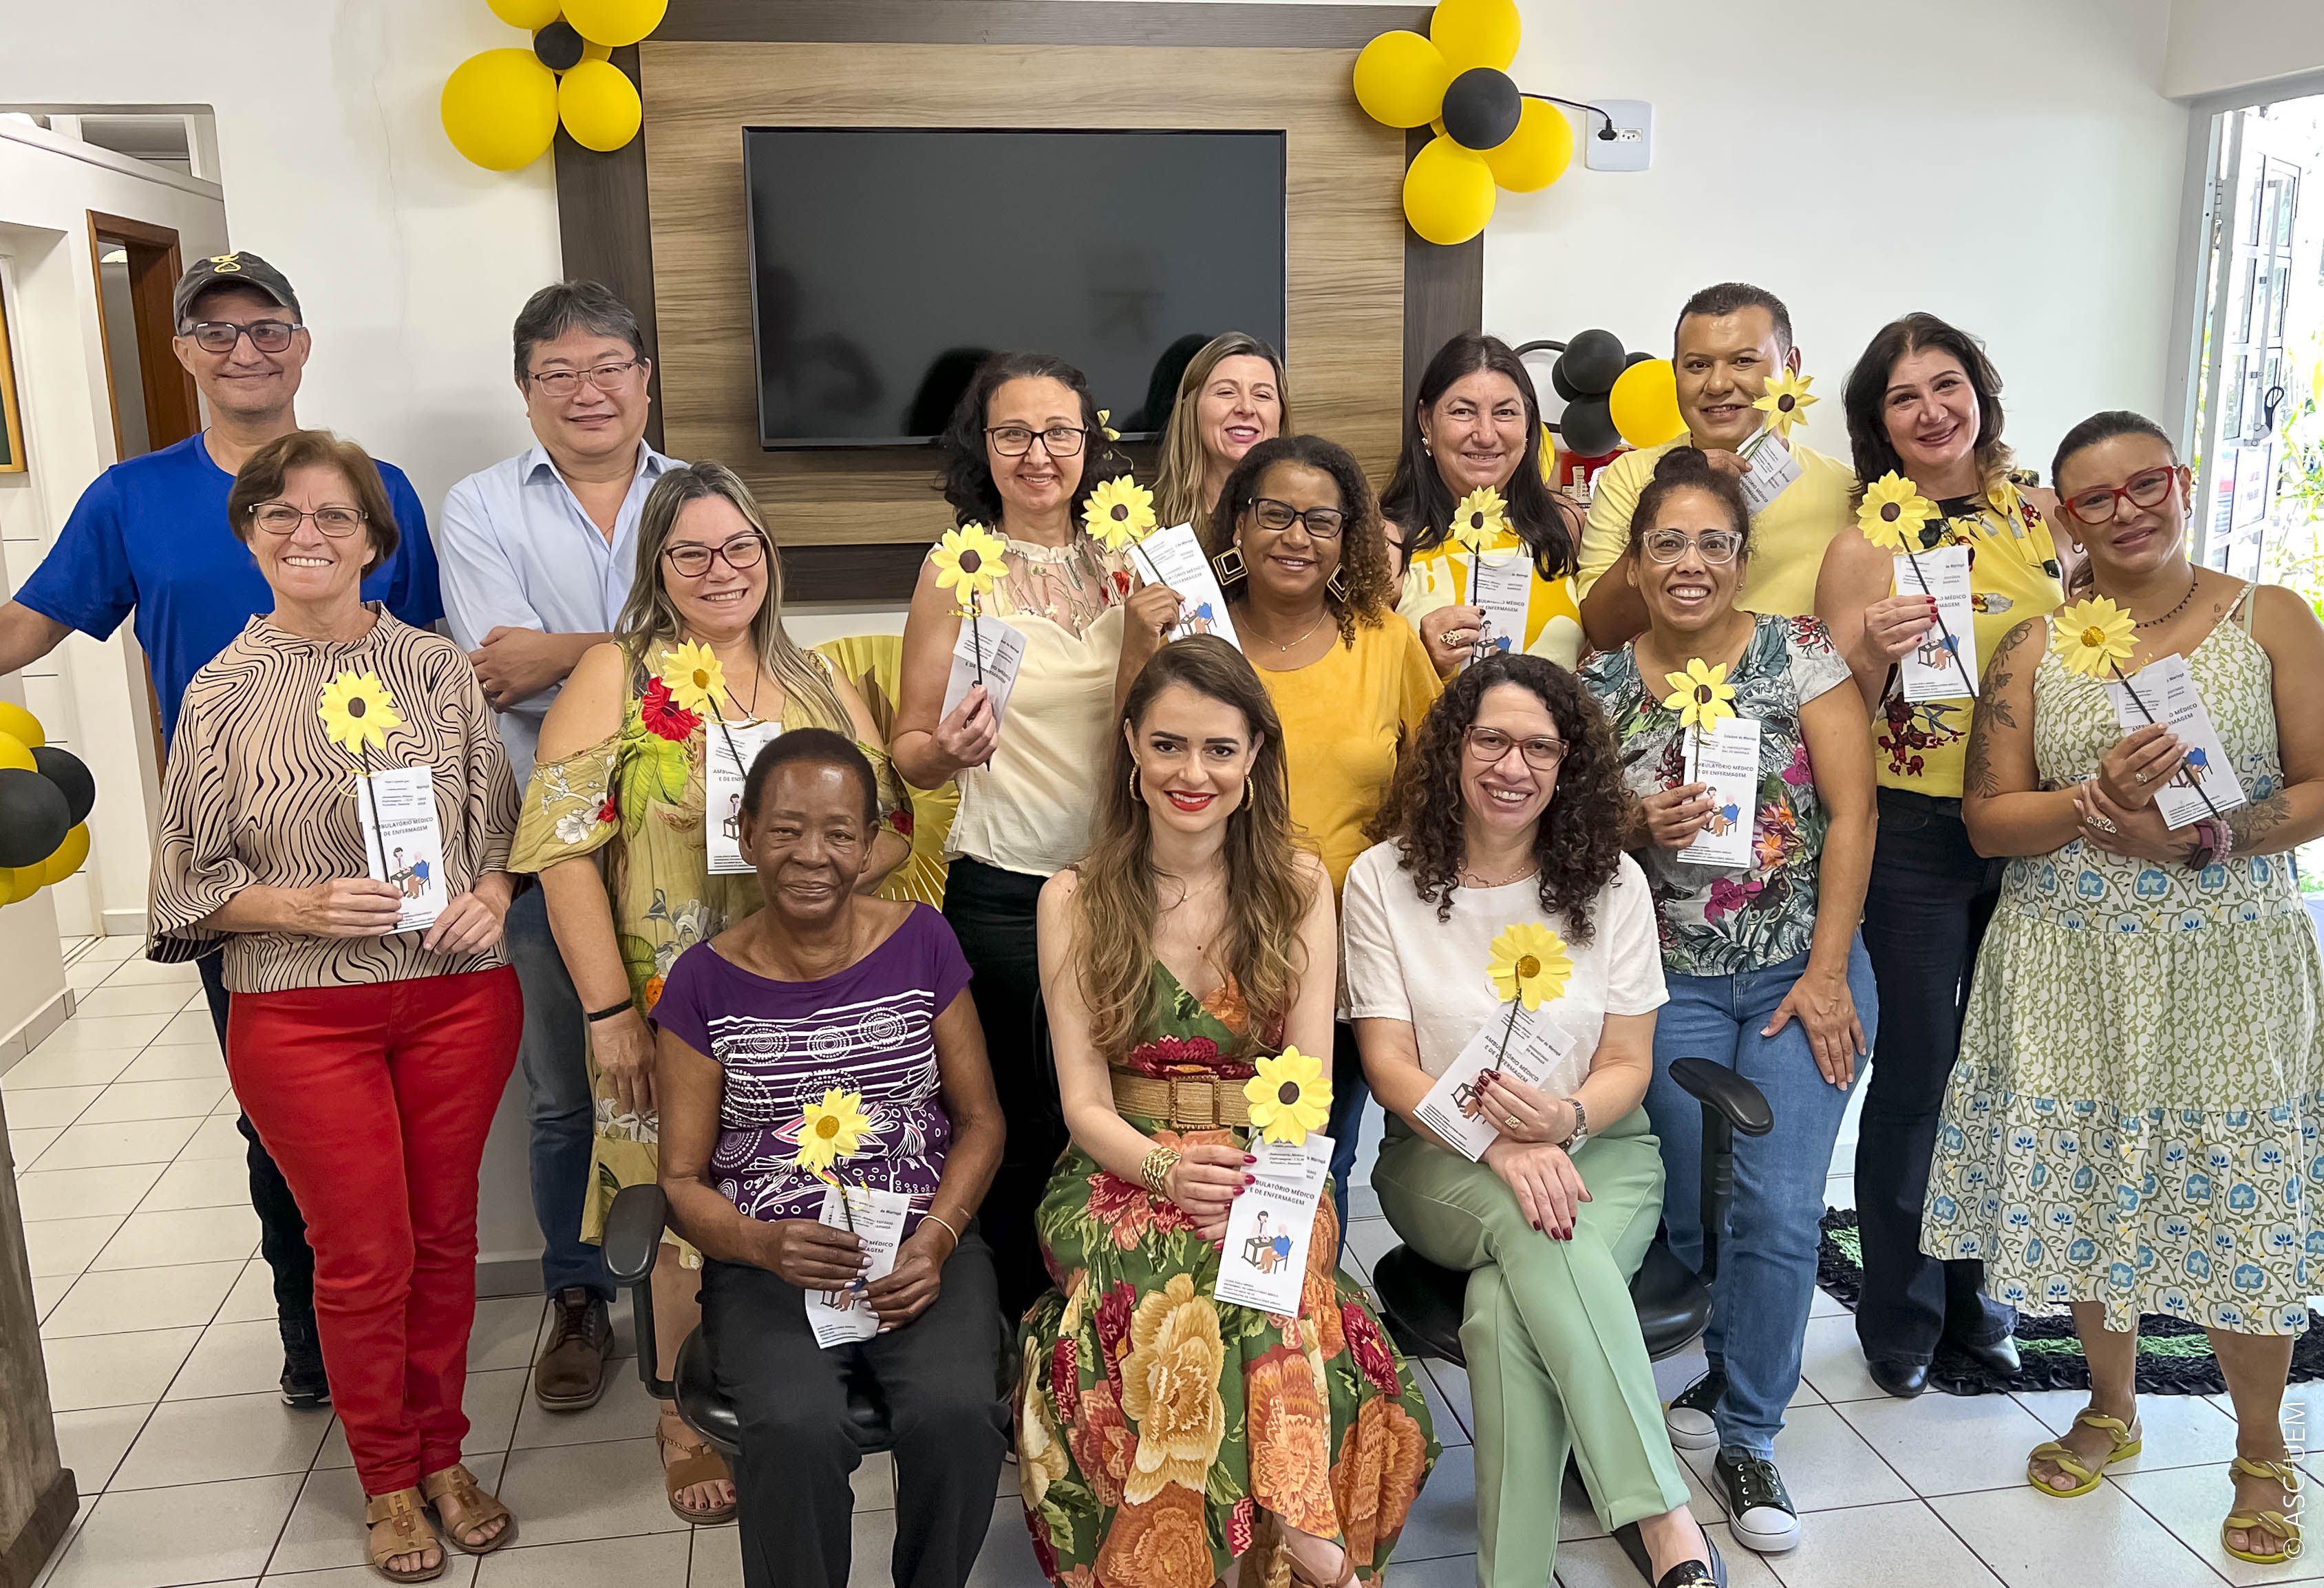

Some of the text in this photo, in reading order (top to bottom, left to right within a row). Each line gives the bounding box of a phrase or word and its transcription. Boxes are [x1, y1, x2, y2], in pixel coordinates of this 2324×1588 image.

[2174, 703, 2197, 715] MÉDICO
[372, 820, 412, 830] ABULATÓRIO
[392, 825, 428, 836] ENFERMAGEM
[1519, 1064, 1539, 1082] MÉDICO
[1255, 1179, 1315, 1200] BULATÓRIO MÉDICO
[1264, 1190, 1305, 1205] ENFERMAGEM
